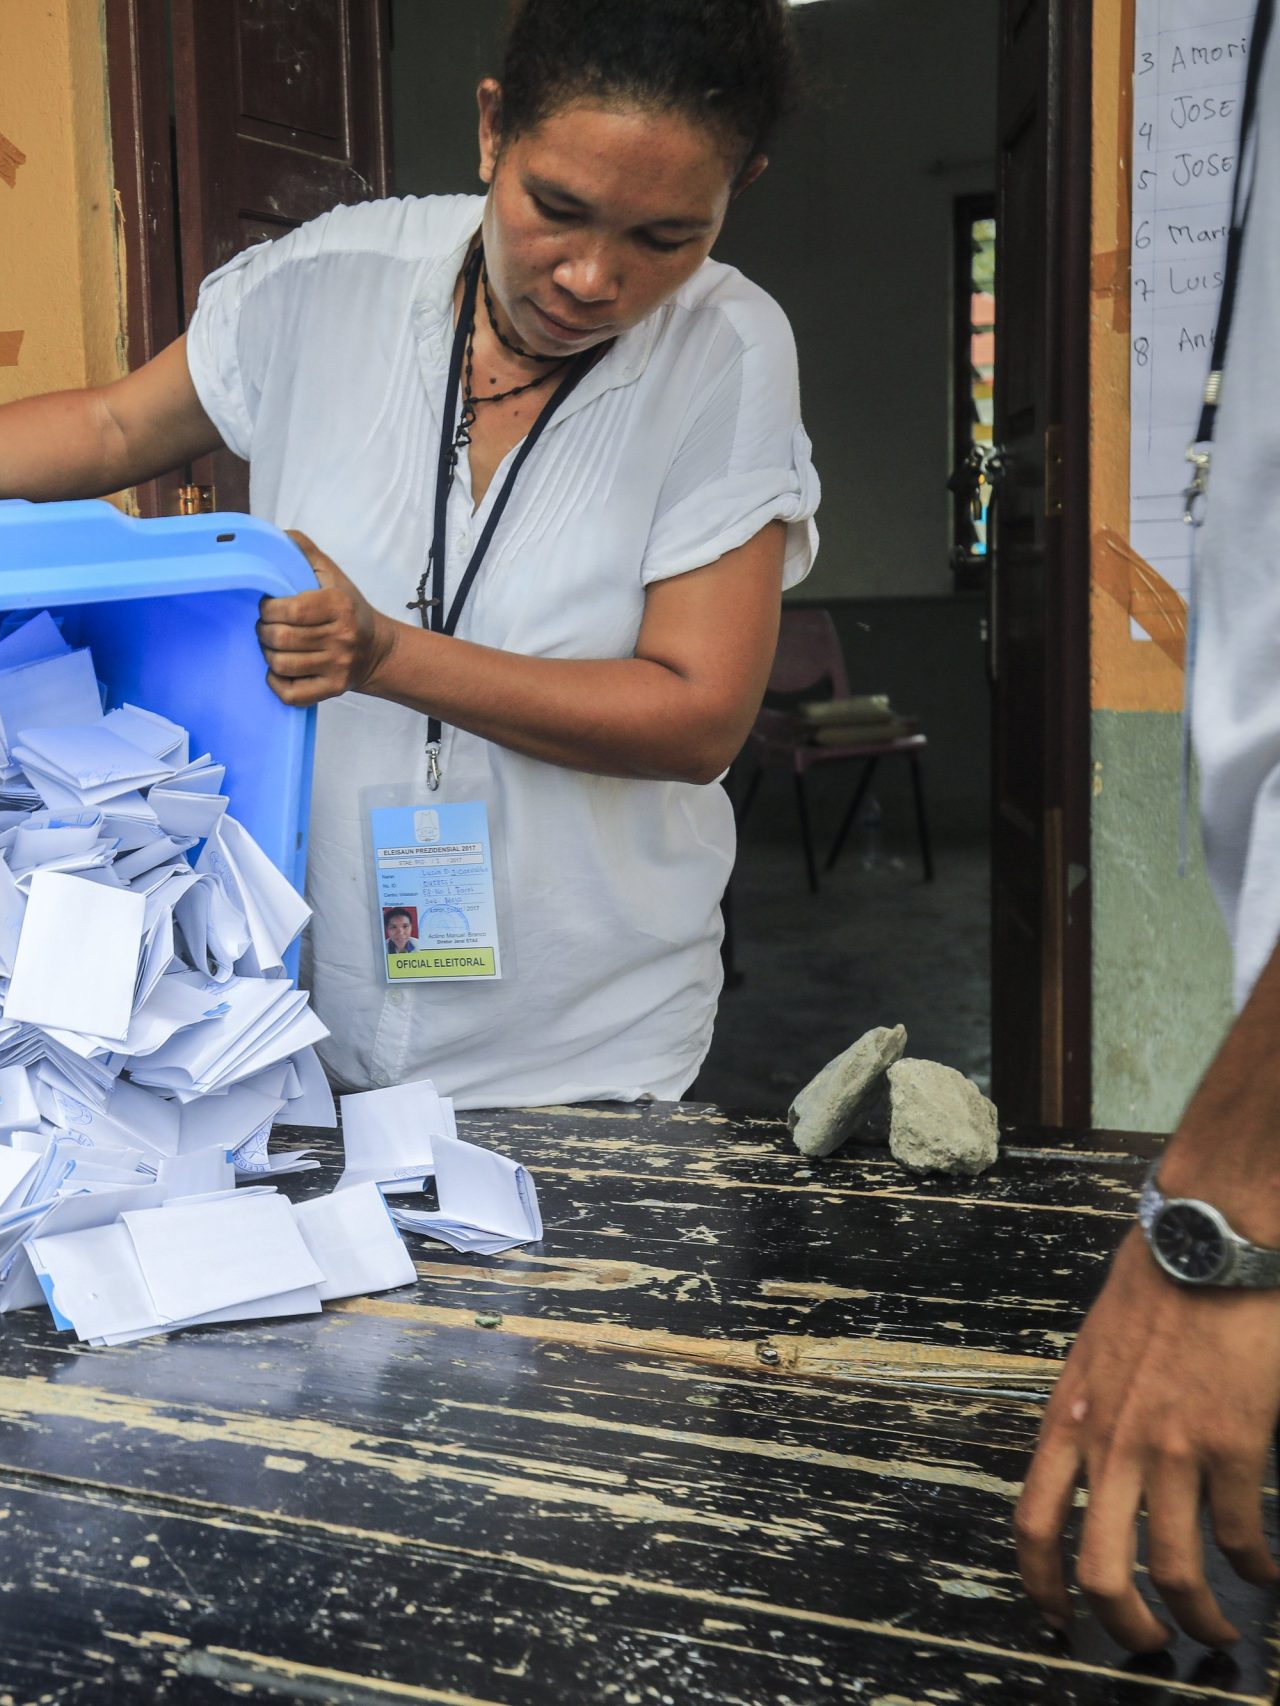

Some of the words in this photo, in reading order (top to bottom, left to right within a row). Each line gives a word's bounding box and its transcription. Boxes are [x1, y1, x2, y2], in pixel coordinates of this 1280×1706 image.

[1138, 52, 1154, 75] 3
[1138, 121, 1152, 151] 4
[1170, 96, 1236, 129] JOSE
[1138, 169, 1157, 190] 5
[1173, 153, 1235, 187] JOSE
[1135, 221, 1151, 249] 6
[1134, 278, 1155, 302] 7
[1133, 336, 1149, 367] 8
[415, 846, 460, 854] PREZIDENSIAL
[396, 959, 432, 969] OFICIAL
[434, 957, 485, 968] ELEITORAL
